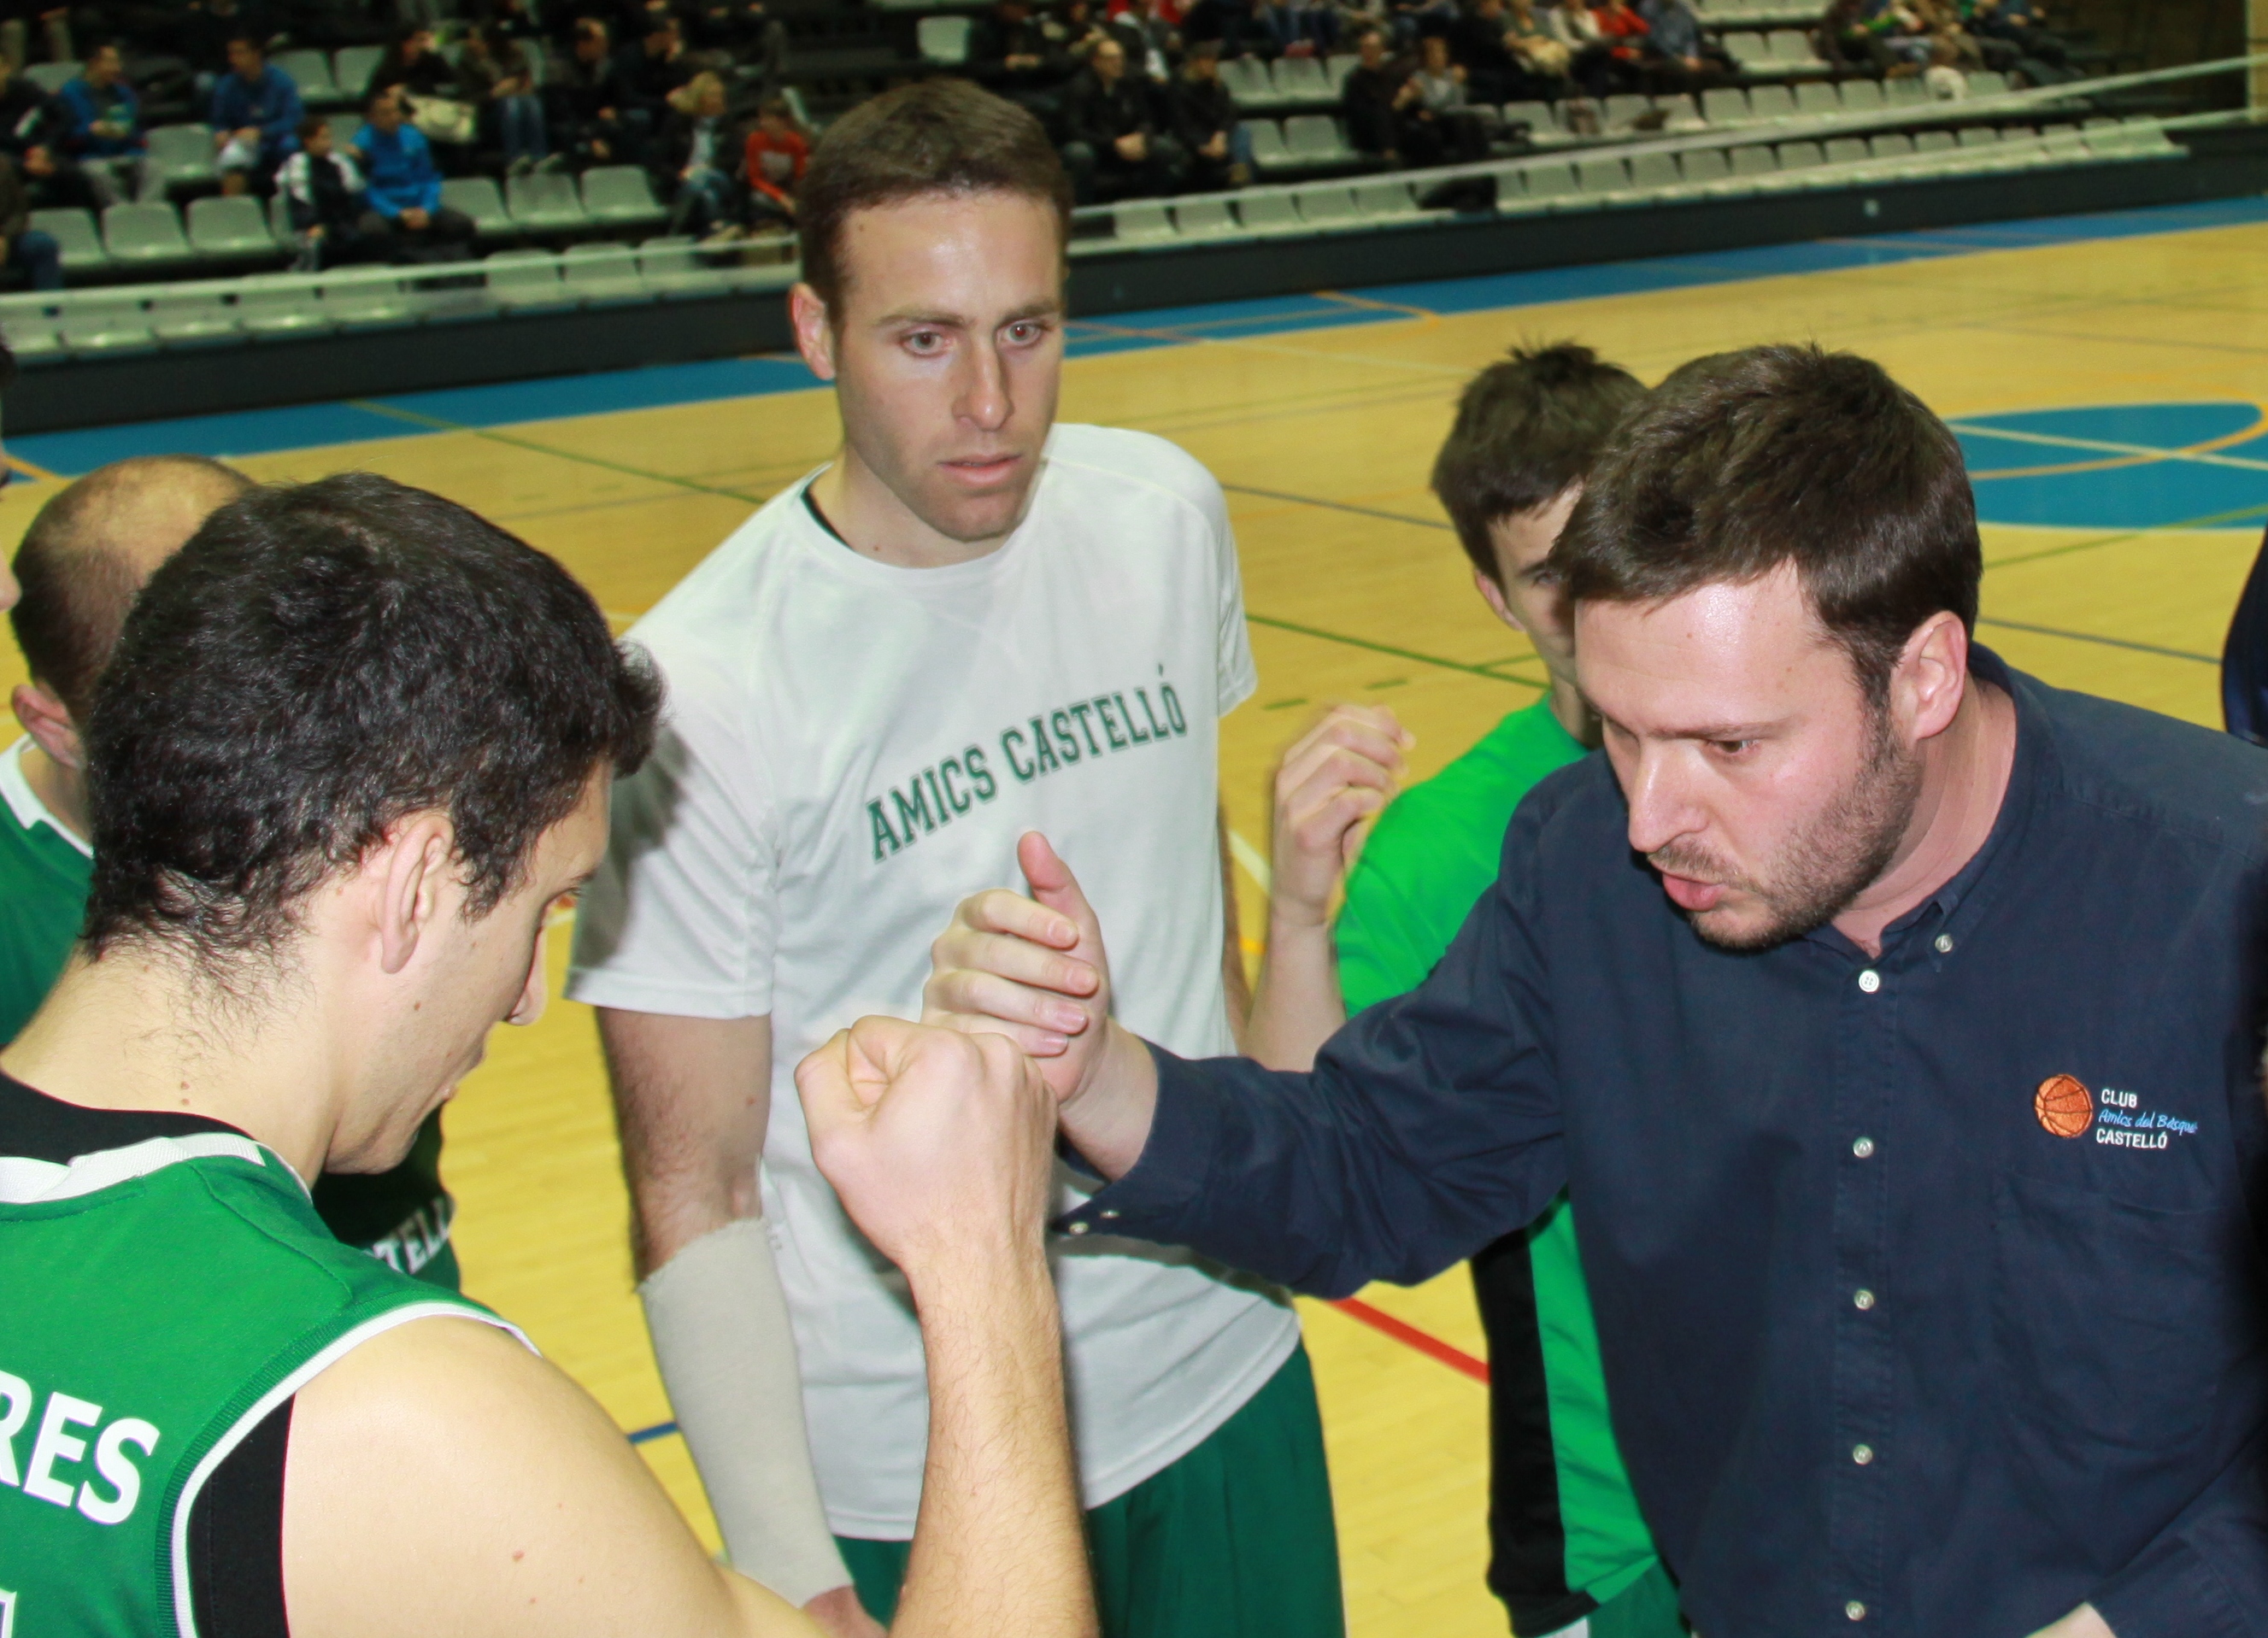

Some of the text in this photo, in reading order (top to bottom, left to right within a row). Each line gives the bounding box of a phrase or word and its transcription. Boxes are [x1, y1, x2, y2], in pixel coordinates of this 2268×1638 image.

[866, 661, 1189, 864] AMICS CASTELLÓ
[2101, 1088, 2138, 1109] CLUB
[2098, 1109, 2133, 1127] Amics
[2135, 1112, 2156, 1129] del
[2096, 1128, 2168, 1149] CASTELLÓ
[363, 1197, 450, 1275] TELL
